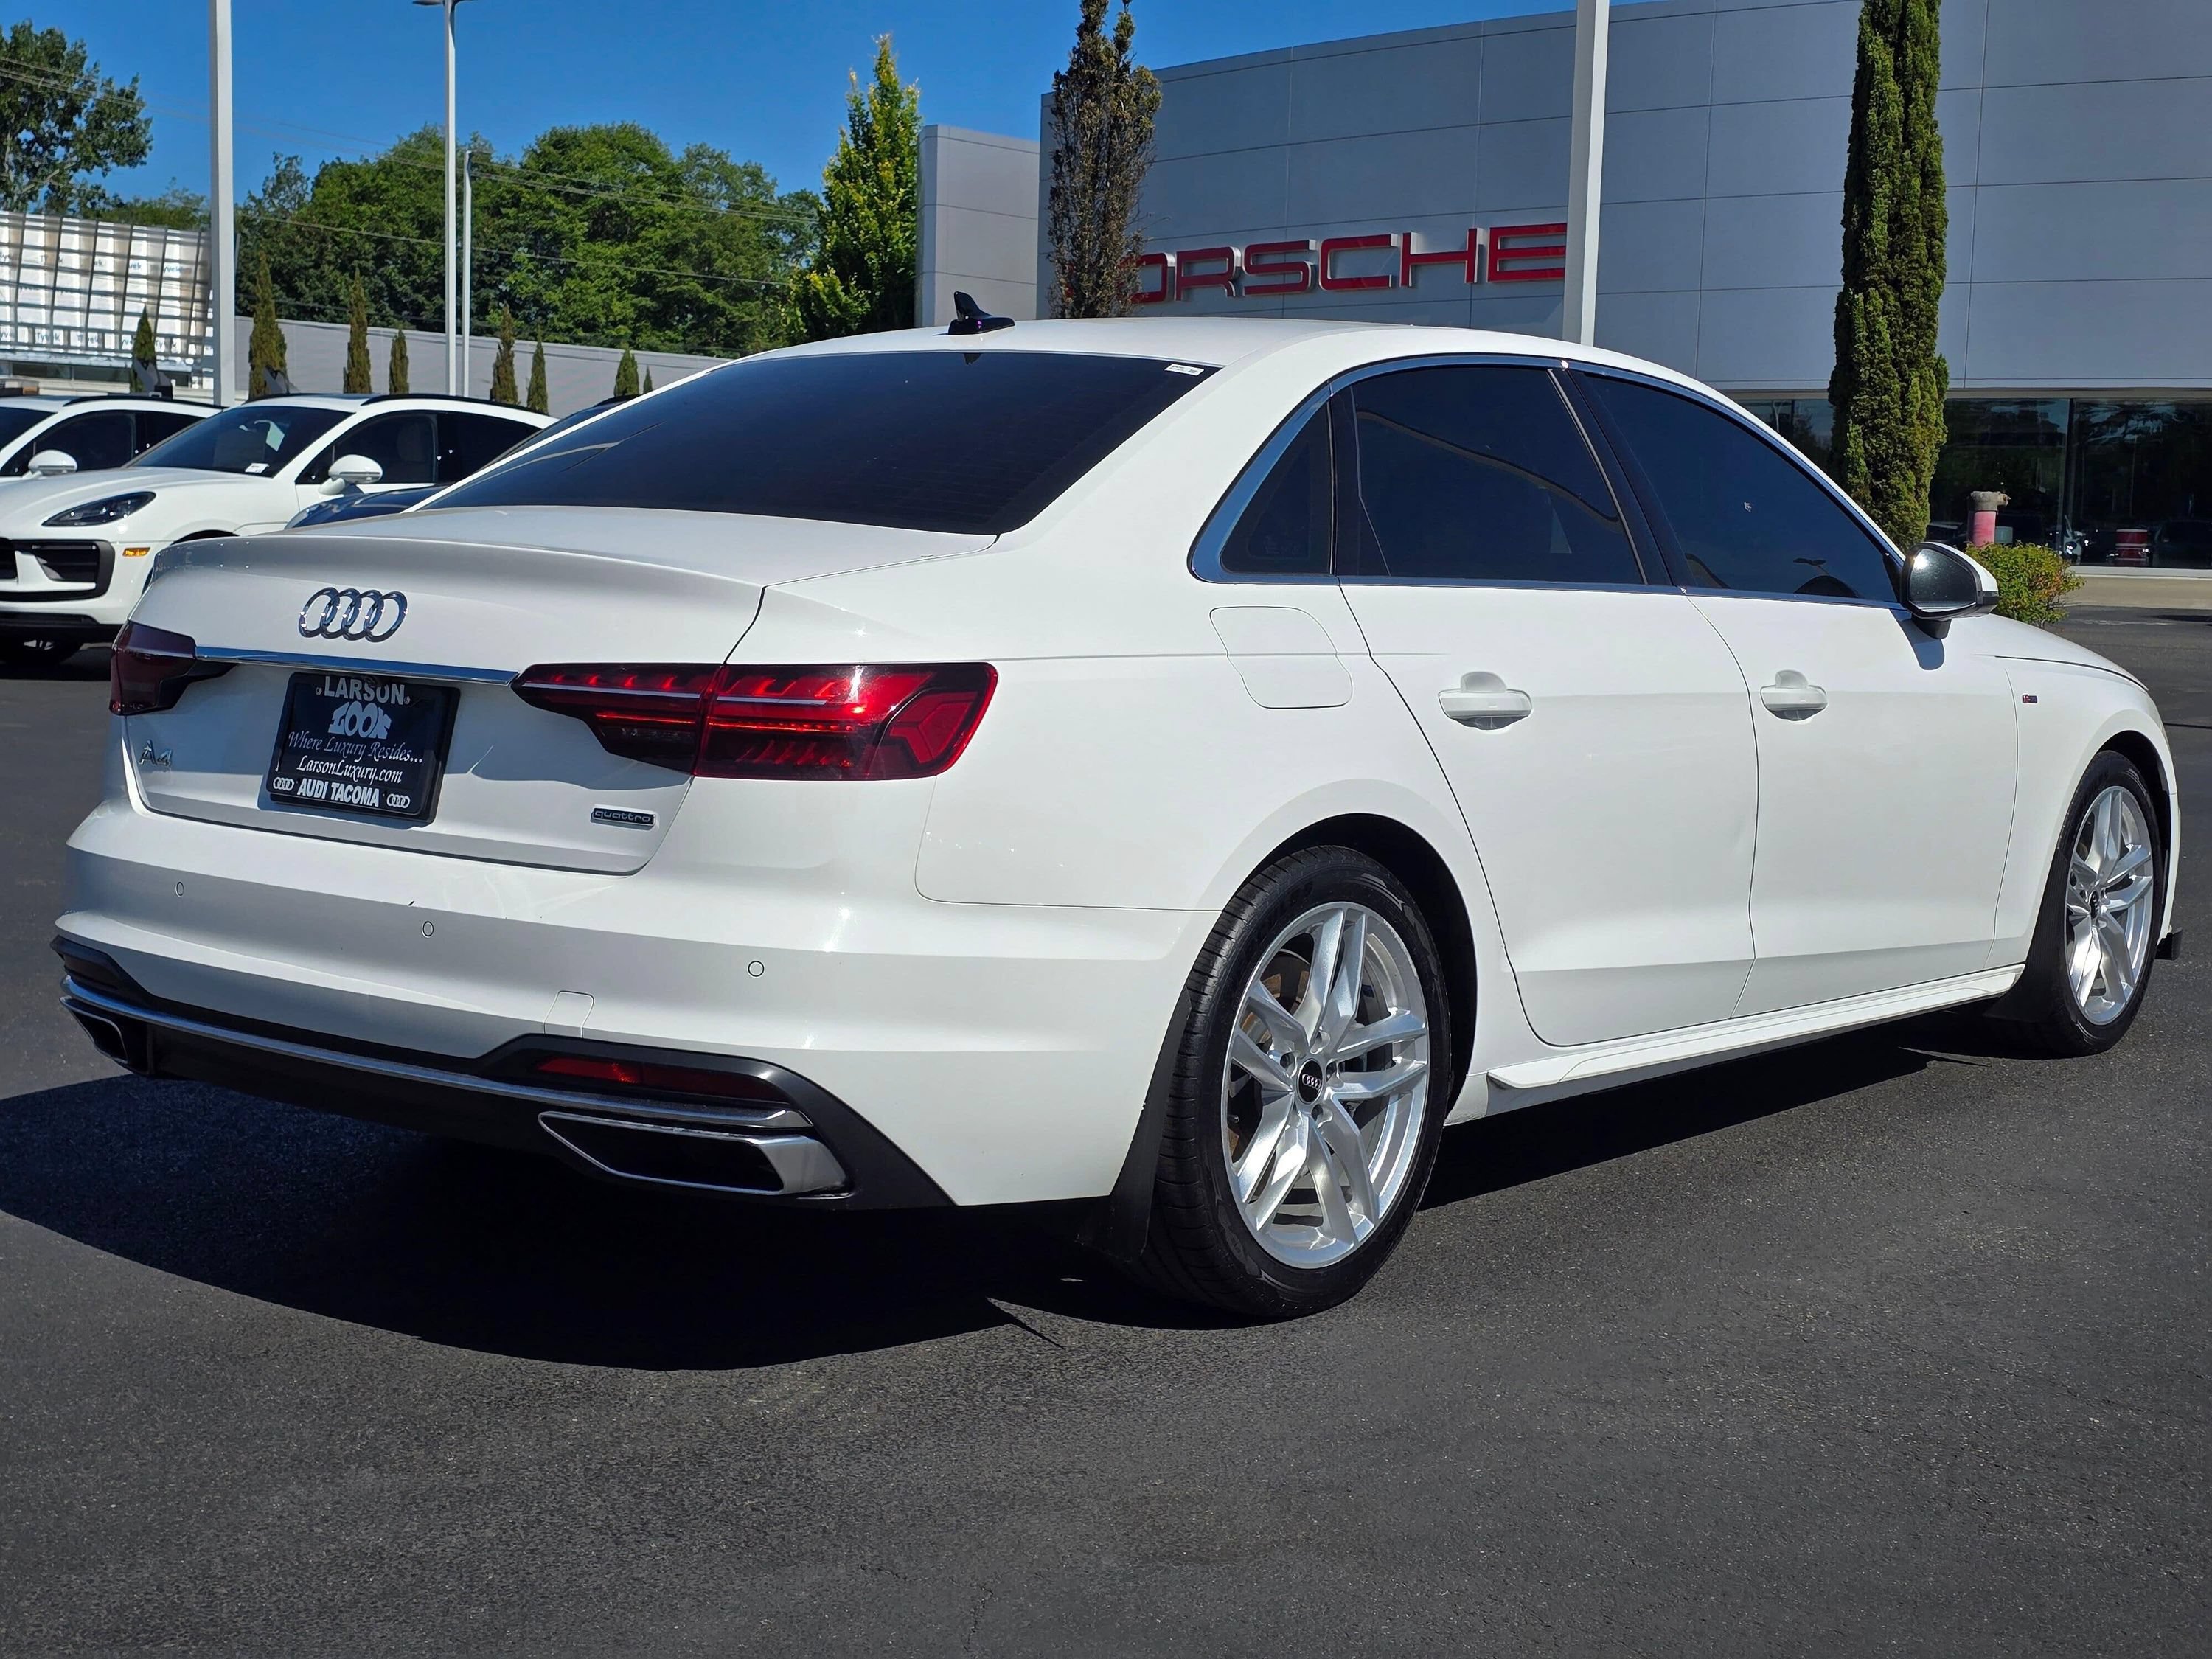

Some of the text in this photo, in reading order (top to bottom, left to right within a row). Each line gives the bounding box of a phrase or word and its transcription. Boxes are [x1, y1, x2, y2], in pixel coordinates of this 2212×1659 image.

[1065, 222, 1568, 304] ORSCHE
[324, 676, 405, 705] LARSON
[139, 740, 173, 767] A4
[288, 731, 422, 764] Where Luxury Resides...
[296, 755, 403, 785] LarsonLuxury.com
[297, 778, 380, 807] AUDI TACOMA
[594, 810, 651, 823] quattro
